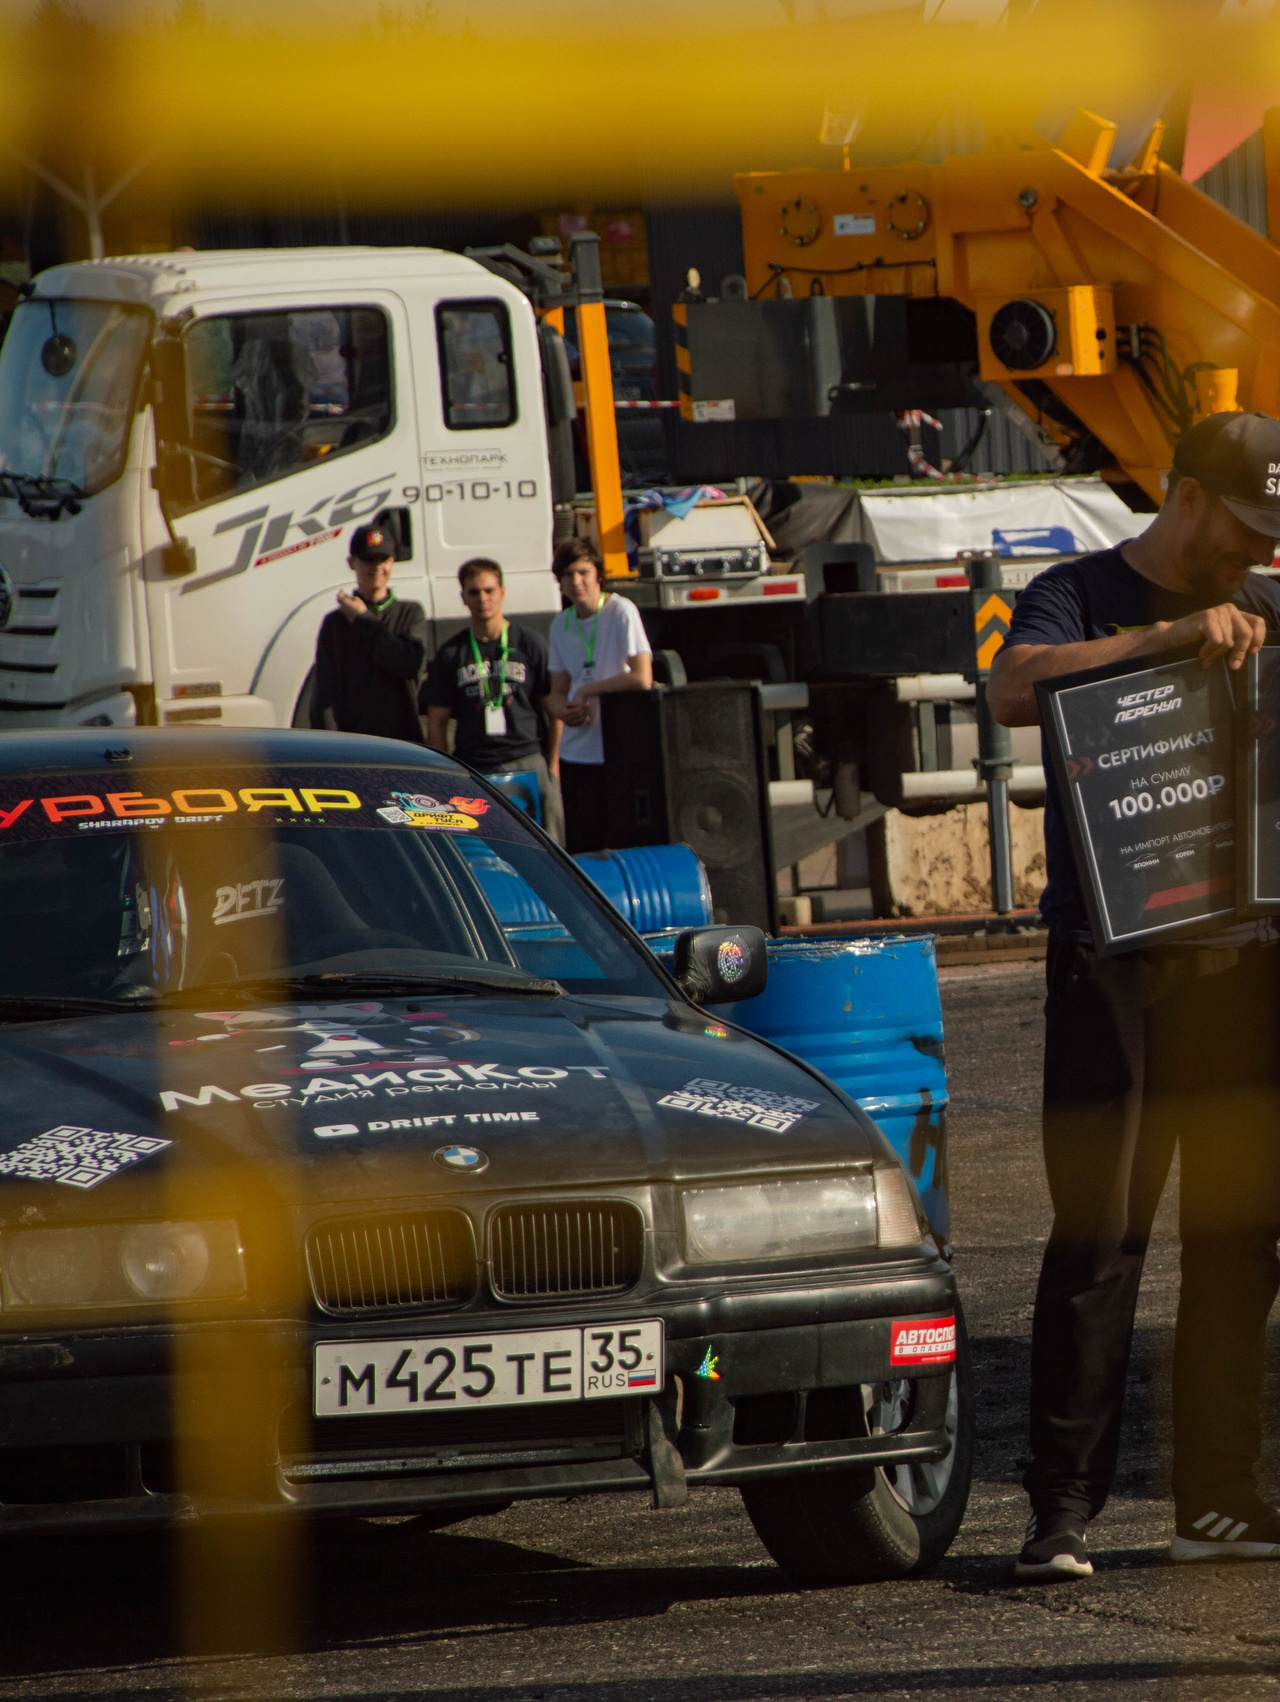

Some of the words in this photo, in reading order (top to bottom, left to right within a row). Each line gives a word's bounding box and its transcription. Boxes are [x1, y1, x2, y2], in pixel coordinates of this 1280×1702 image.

[421, 452, 508, 466] ТЕХНОПАРК
[402, 479, 537, 504] 90-10-10
[1116, 684, 1175, 707] ЧЕСТЕР
[1098, 728, 1216, 769] СЕРТИФИКАТ
[1131, 777, 1149, 789] НА
[1151, 765, 1192, 784] СУММУ
[78, 817, 165, 830] SHARAPOV
[174, 814, 223, 824] DRIFT
[1120, 846, 1134, 855] НА
[1135, 835, 1170, 851] ИМПОРТ
[367, 1114, 457, 1131] DRIFT
[463, 1111, 541, 1123] TIME
[590, 1328, 643, 1373] 35
[588, 1372, 627, 1390] RUS
